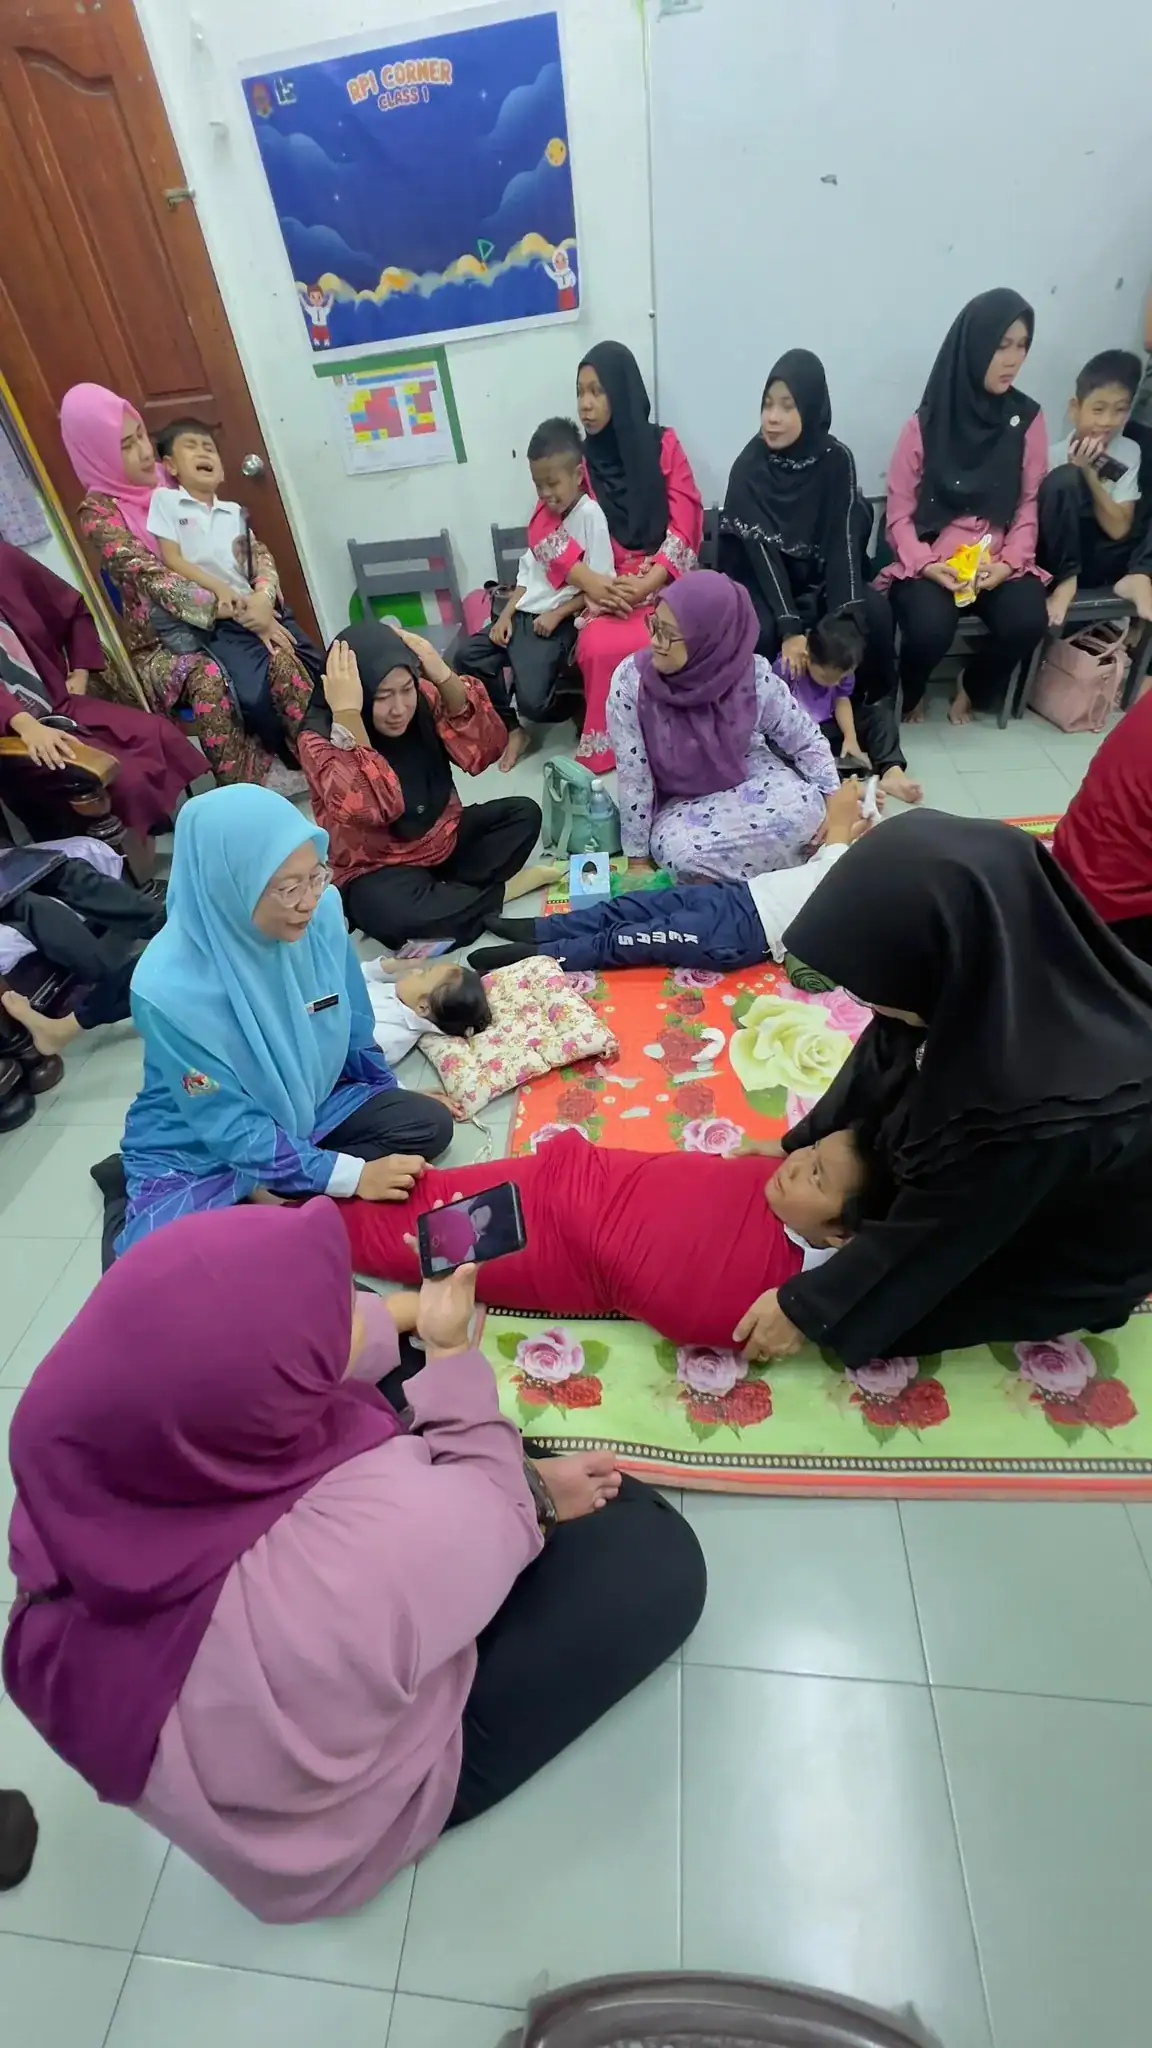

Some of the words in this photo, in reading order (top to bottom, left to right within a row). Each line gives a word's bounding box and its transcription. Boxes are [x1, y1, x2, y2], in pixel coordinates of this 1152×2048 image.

[347, 70, 379, 104] RPI
[381, 58, 453, 90] CORNER
[378, 86, 419, 112] CLASS
[617, 930, 699, 946] KEMAS
